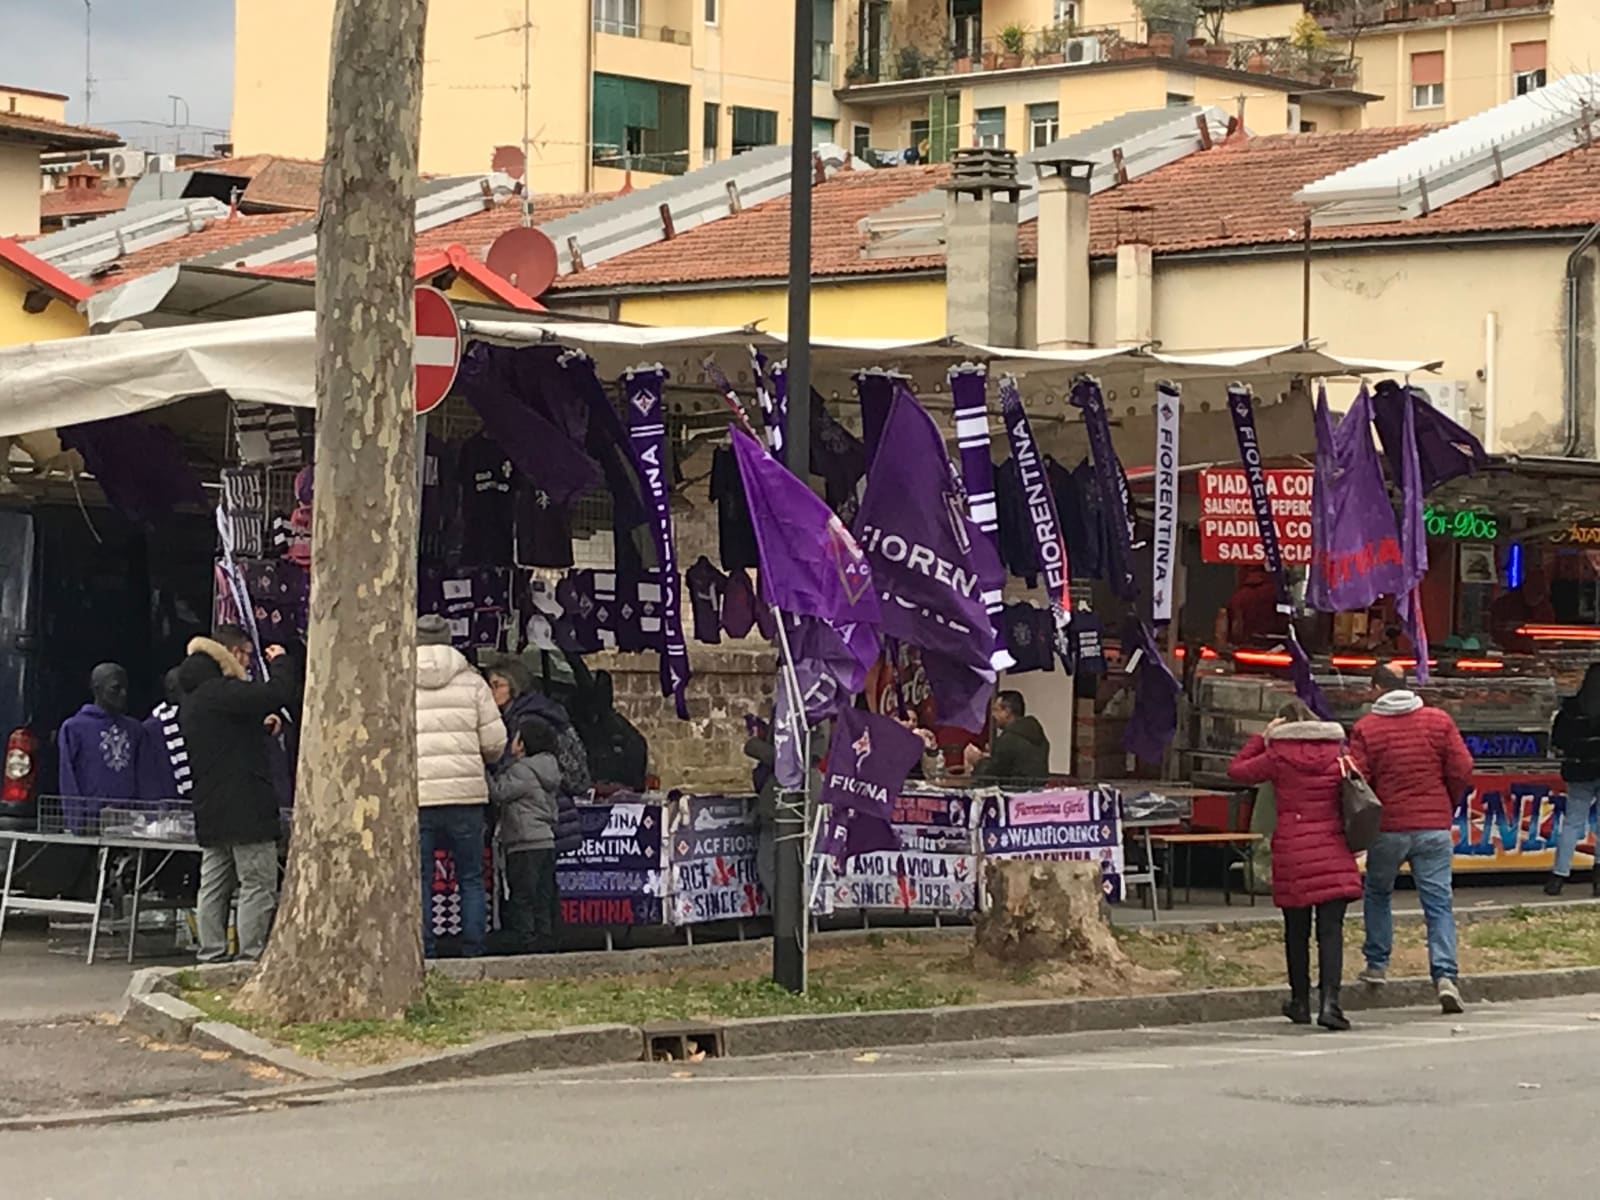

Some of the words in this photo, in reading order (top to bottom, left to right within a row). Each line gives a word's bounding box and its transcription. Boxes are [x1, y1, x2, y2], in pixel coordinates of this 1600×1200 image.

[1206, 474, 1278, 494] PIADA
[1012, 419, 1064, 589] FIORENTINA
[1155, 428, 1173, 581] FIORENTINA
[694, 838, 720, 855] ACF
[694, 892, 739, 917] SINCE
[852, 882, 892, 905] SINCE
[919, 884, 950, 906] 1926
